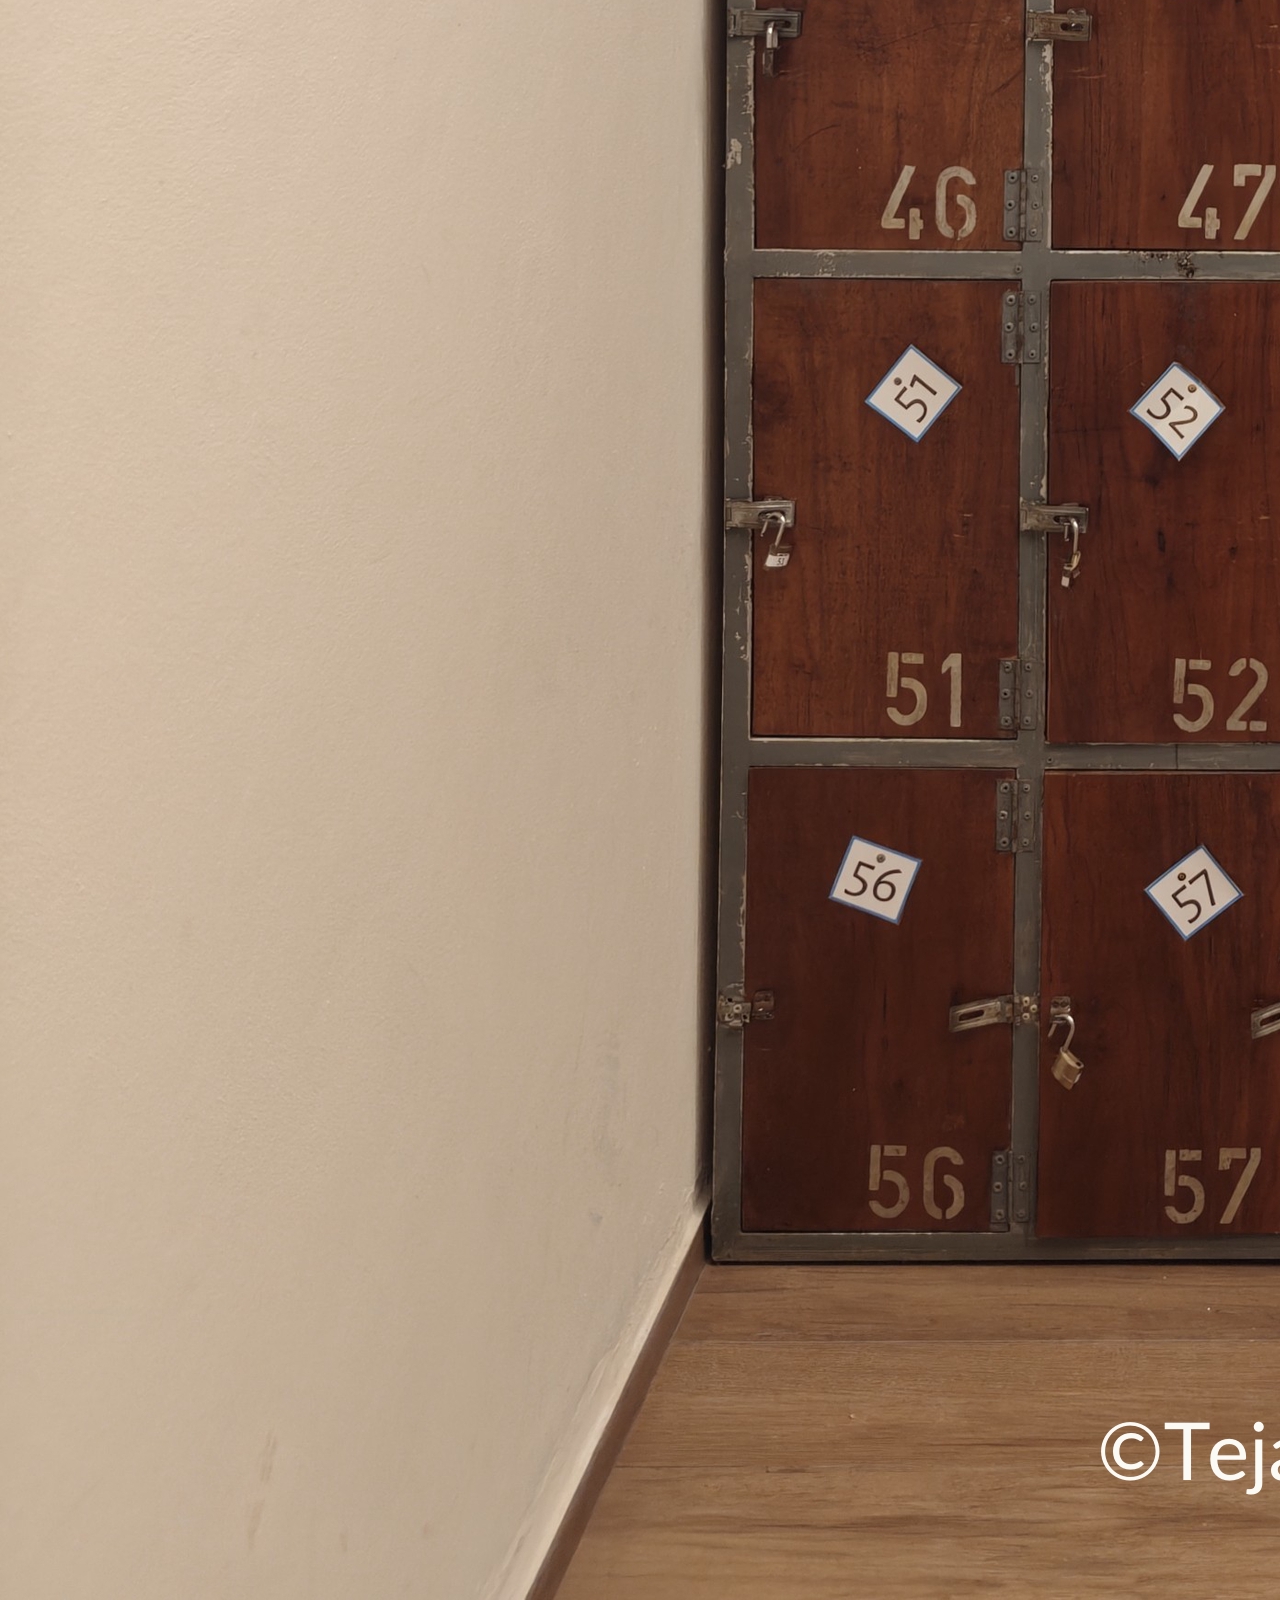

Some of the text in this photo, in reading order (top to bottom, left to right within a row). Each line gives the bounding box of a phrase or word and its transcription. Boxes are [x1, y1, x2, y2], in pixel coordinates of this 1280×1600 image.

[881, 165, 977, 240] 46
[1178, 164, 1276, 240] 47
[894, 375, 937, 423] 51
[1147, 388, 1197, 439] 52
[887, 652, 961, 727] 51
[1174, 658, 1268, 732] 52
[844, 861, 896, 902] 56
[1172, 869, 1215, 923] 57
[869, 1145, 964, 1219] 56
[1165, 1148, 1261, 1224] 57
